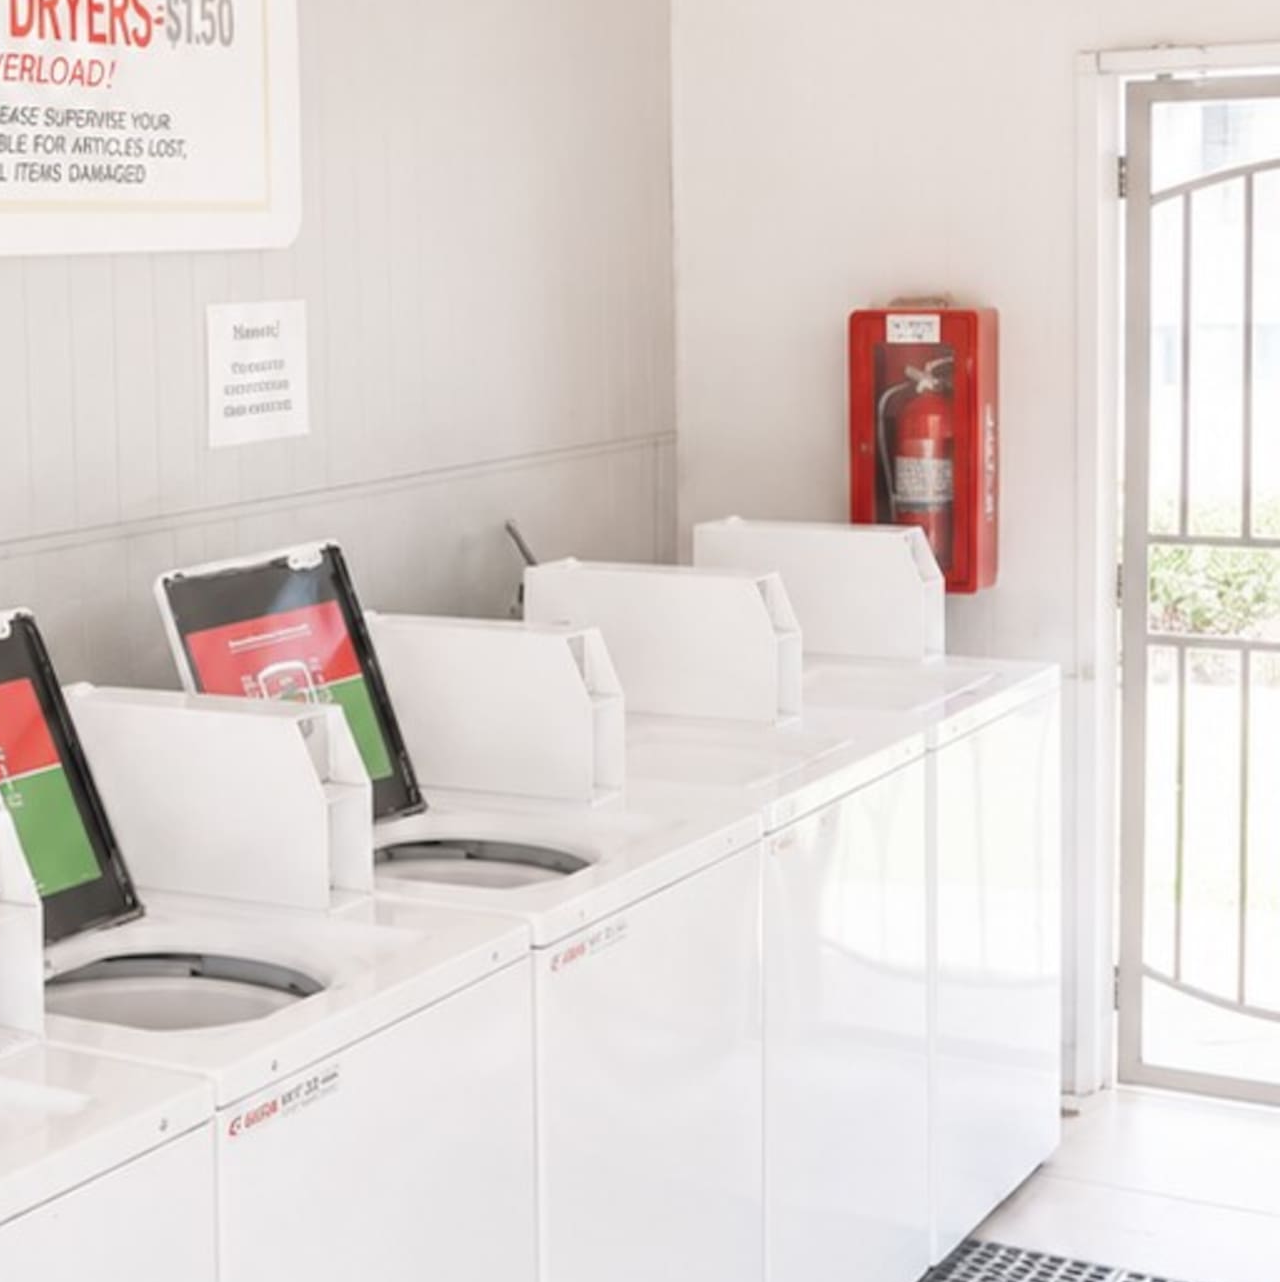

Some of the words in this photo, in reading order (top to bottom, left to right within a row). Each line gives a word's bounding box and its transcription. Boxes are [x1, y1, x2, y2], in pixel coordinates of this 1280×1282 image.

[44, 107, 126, 130] SUPERVISE
[131, 112, 172, 131] YOUR
[33, 134, 66, 155] FOR
[71, 137, 144, 158] ARTICLES
[14, 162, 63, 183] ITEMS
[68, 163, 147, 184] DAMAGED
